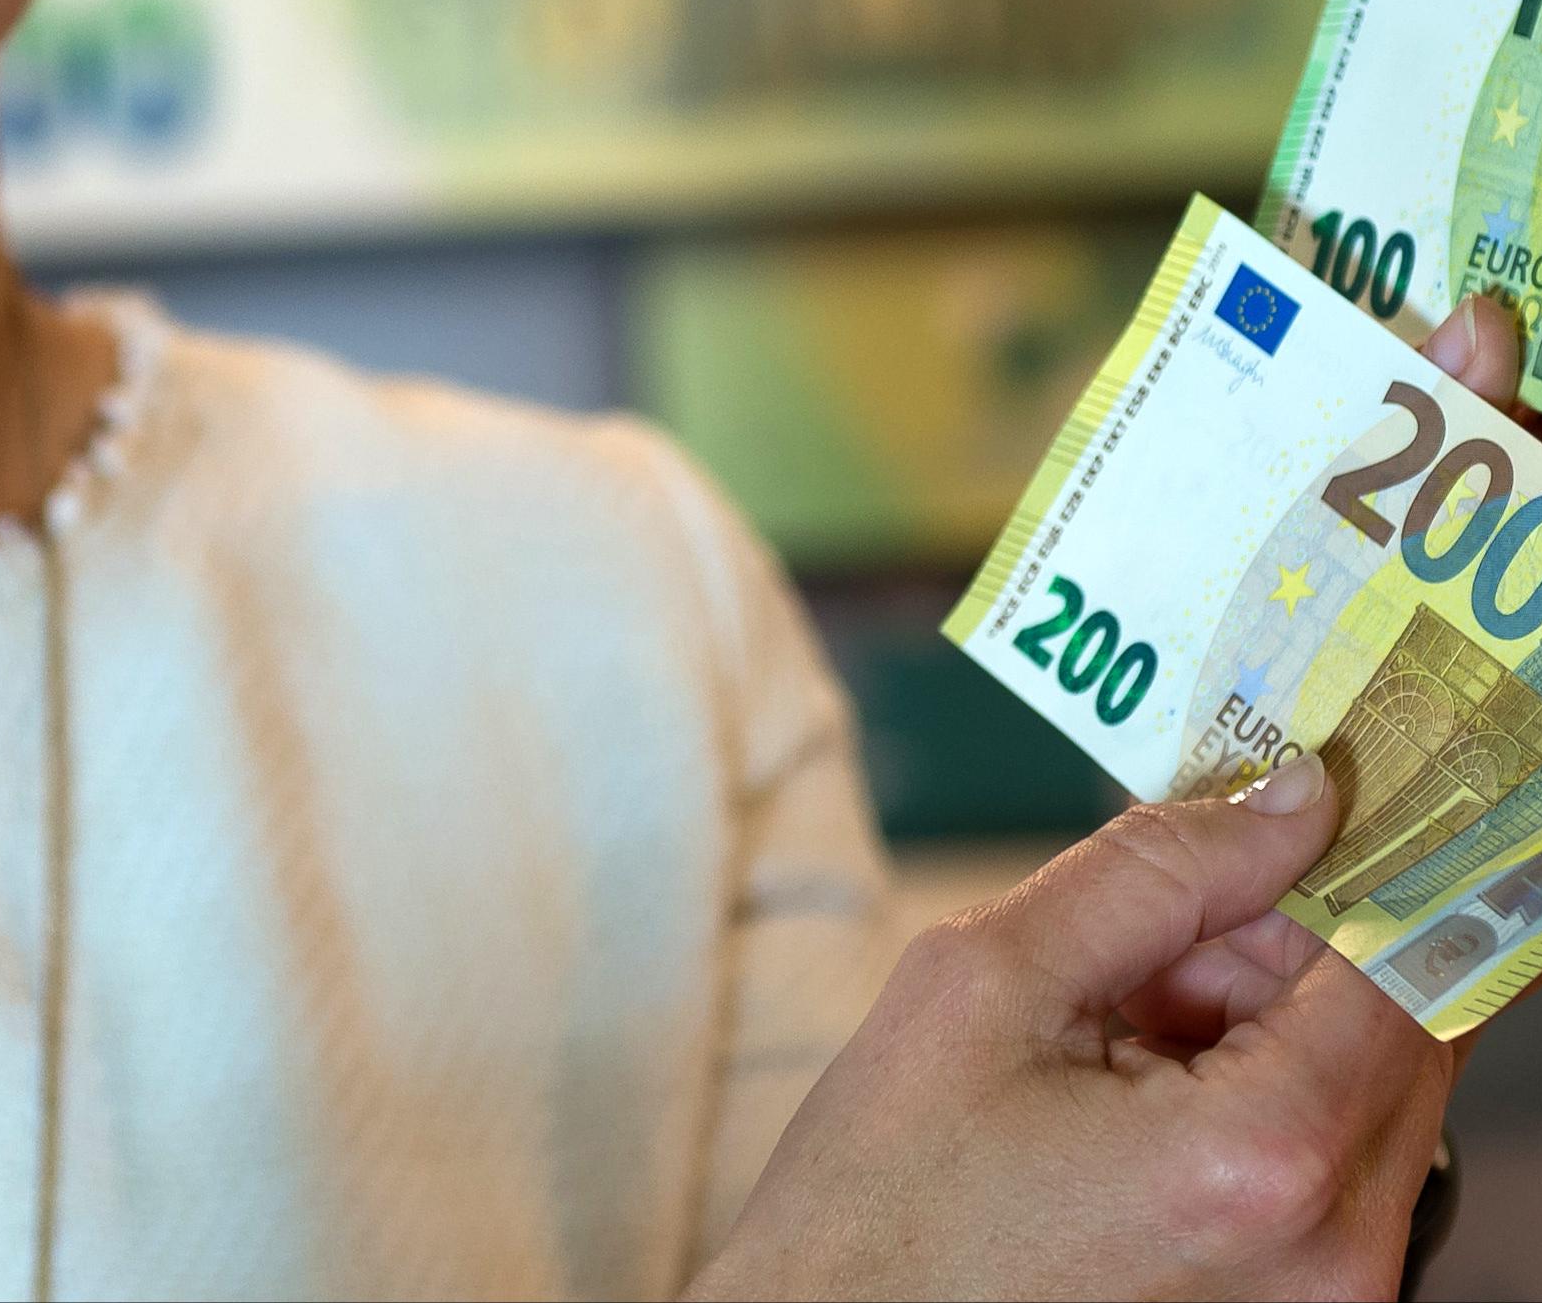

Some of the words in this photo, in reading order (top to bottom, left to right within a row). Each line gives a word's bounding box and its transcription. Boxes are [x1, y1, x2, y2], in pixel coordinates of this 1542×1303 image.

[1311, 210, 1416, 321] 100
[1126, 385, 1149, 415] ESB
[1147, 349, 1171, 382] EKB
[1188, 276, 1213, 308] EBC
[1013, 574, 1157, 727] 200
[1216, 692, 1303, 770] EURO
